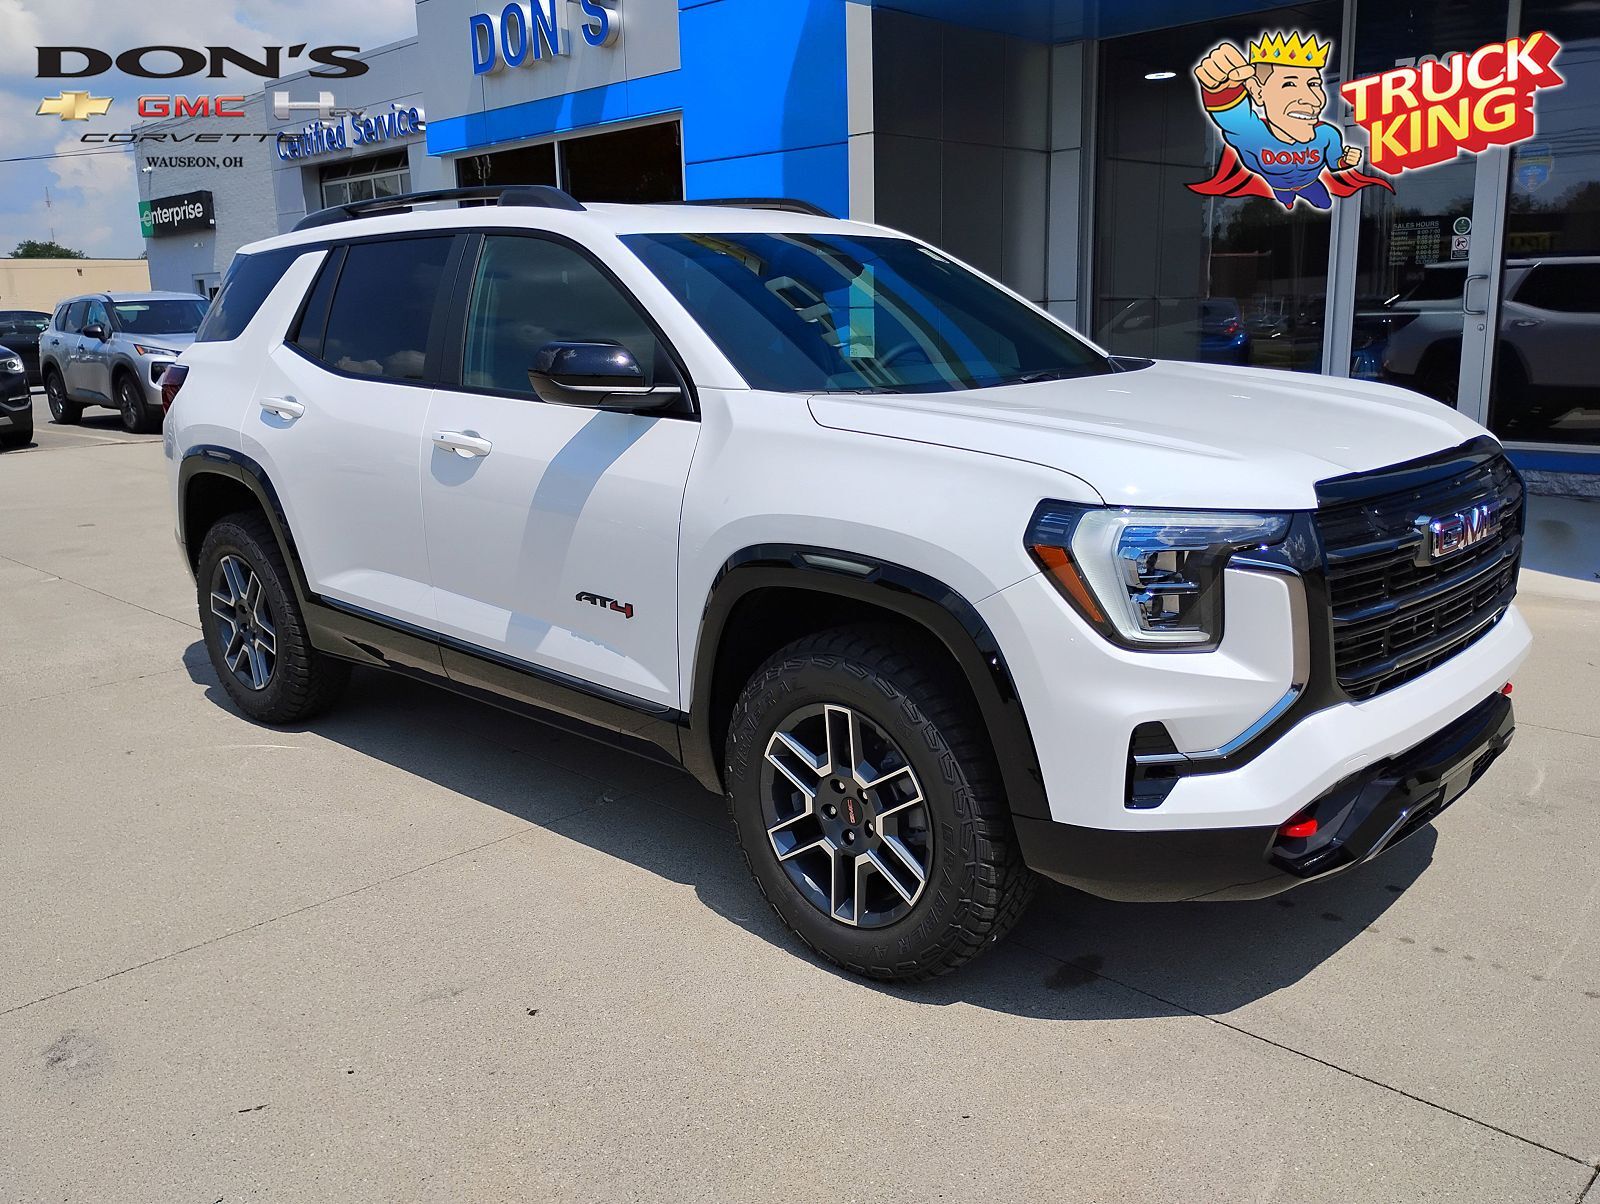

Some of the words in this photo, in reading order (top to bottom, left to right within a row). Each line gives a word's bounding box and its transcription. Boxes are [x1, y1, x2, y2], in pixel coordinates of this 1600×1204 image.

[276, 116, 347, 161] Certified
[351, 103, 420, 146] Service
[142, 199, 204, 228] enterprise
[1416, 220, 1439, 228] HOURS
[1431, 504, 1502, 557] GM
[575, 591, 634, 619] AT4
